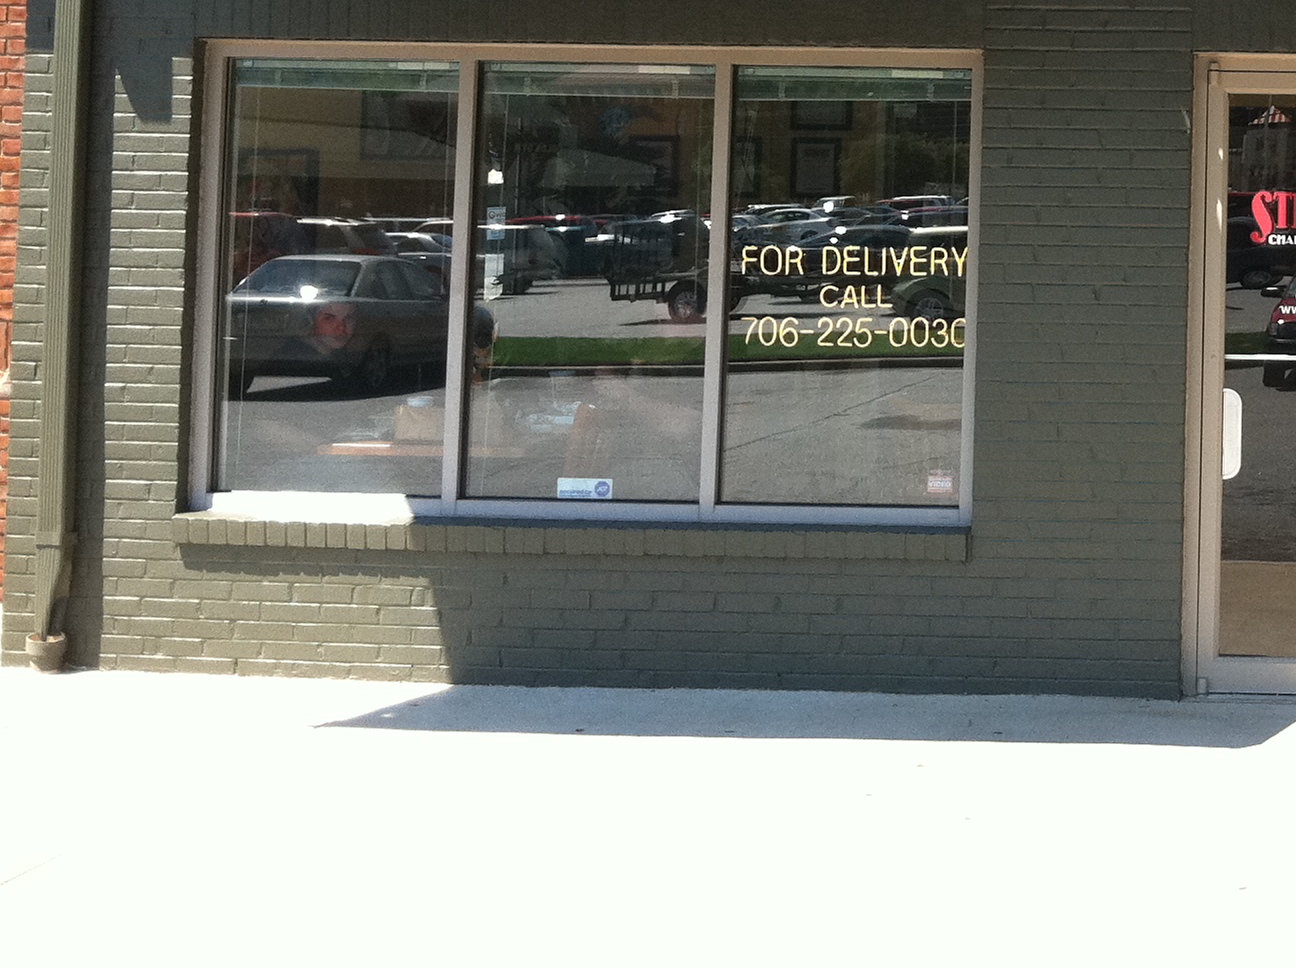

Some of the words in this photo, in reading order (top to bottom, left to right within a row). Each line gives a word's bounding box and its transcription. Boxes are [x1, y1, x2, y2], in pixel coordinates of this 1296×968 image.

[740, 244, 805, 277] FOR
[821, 245, 970, 278] DELIVERY
[818, 284, 894, 309] CALL
